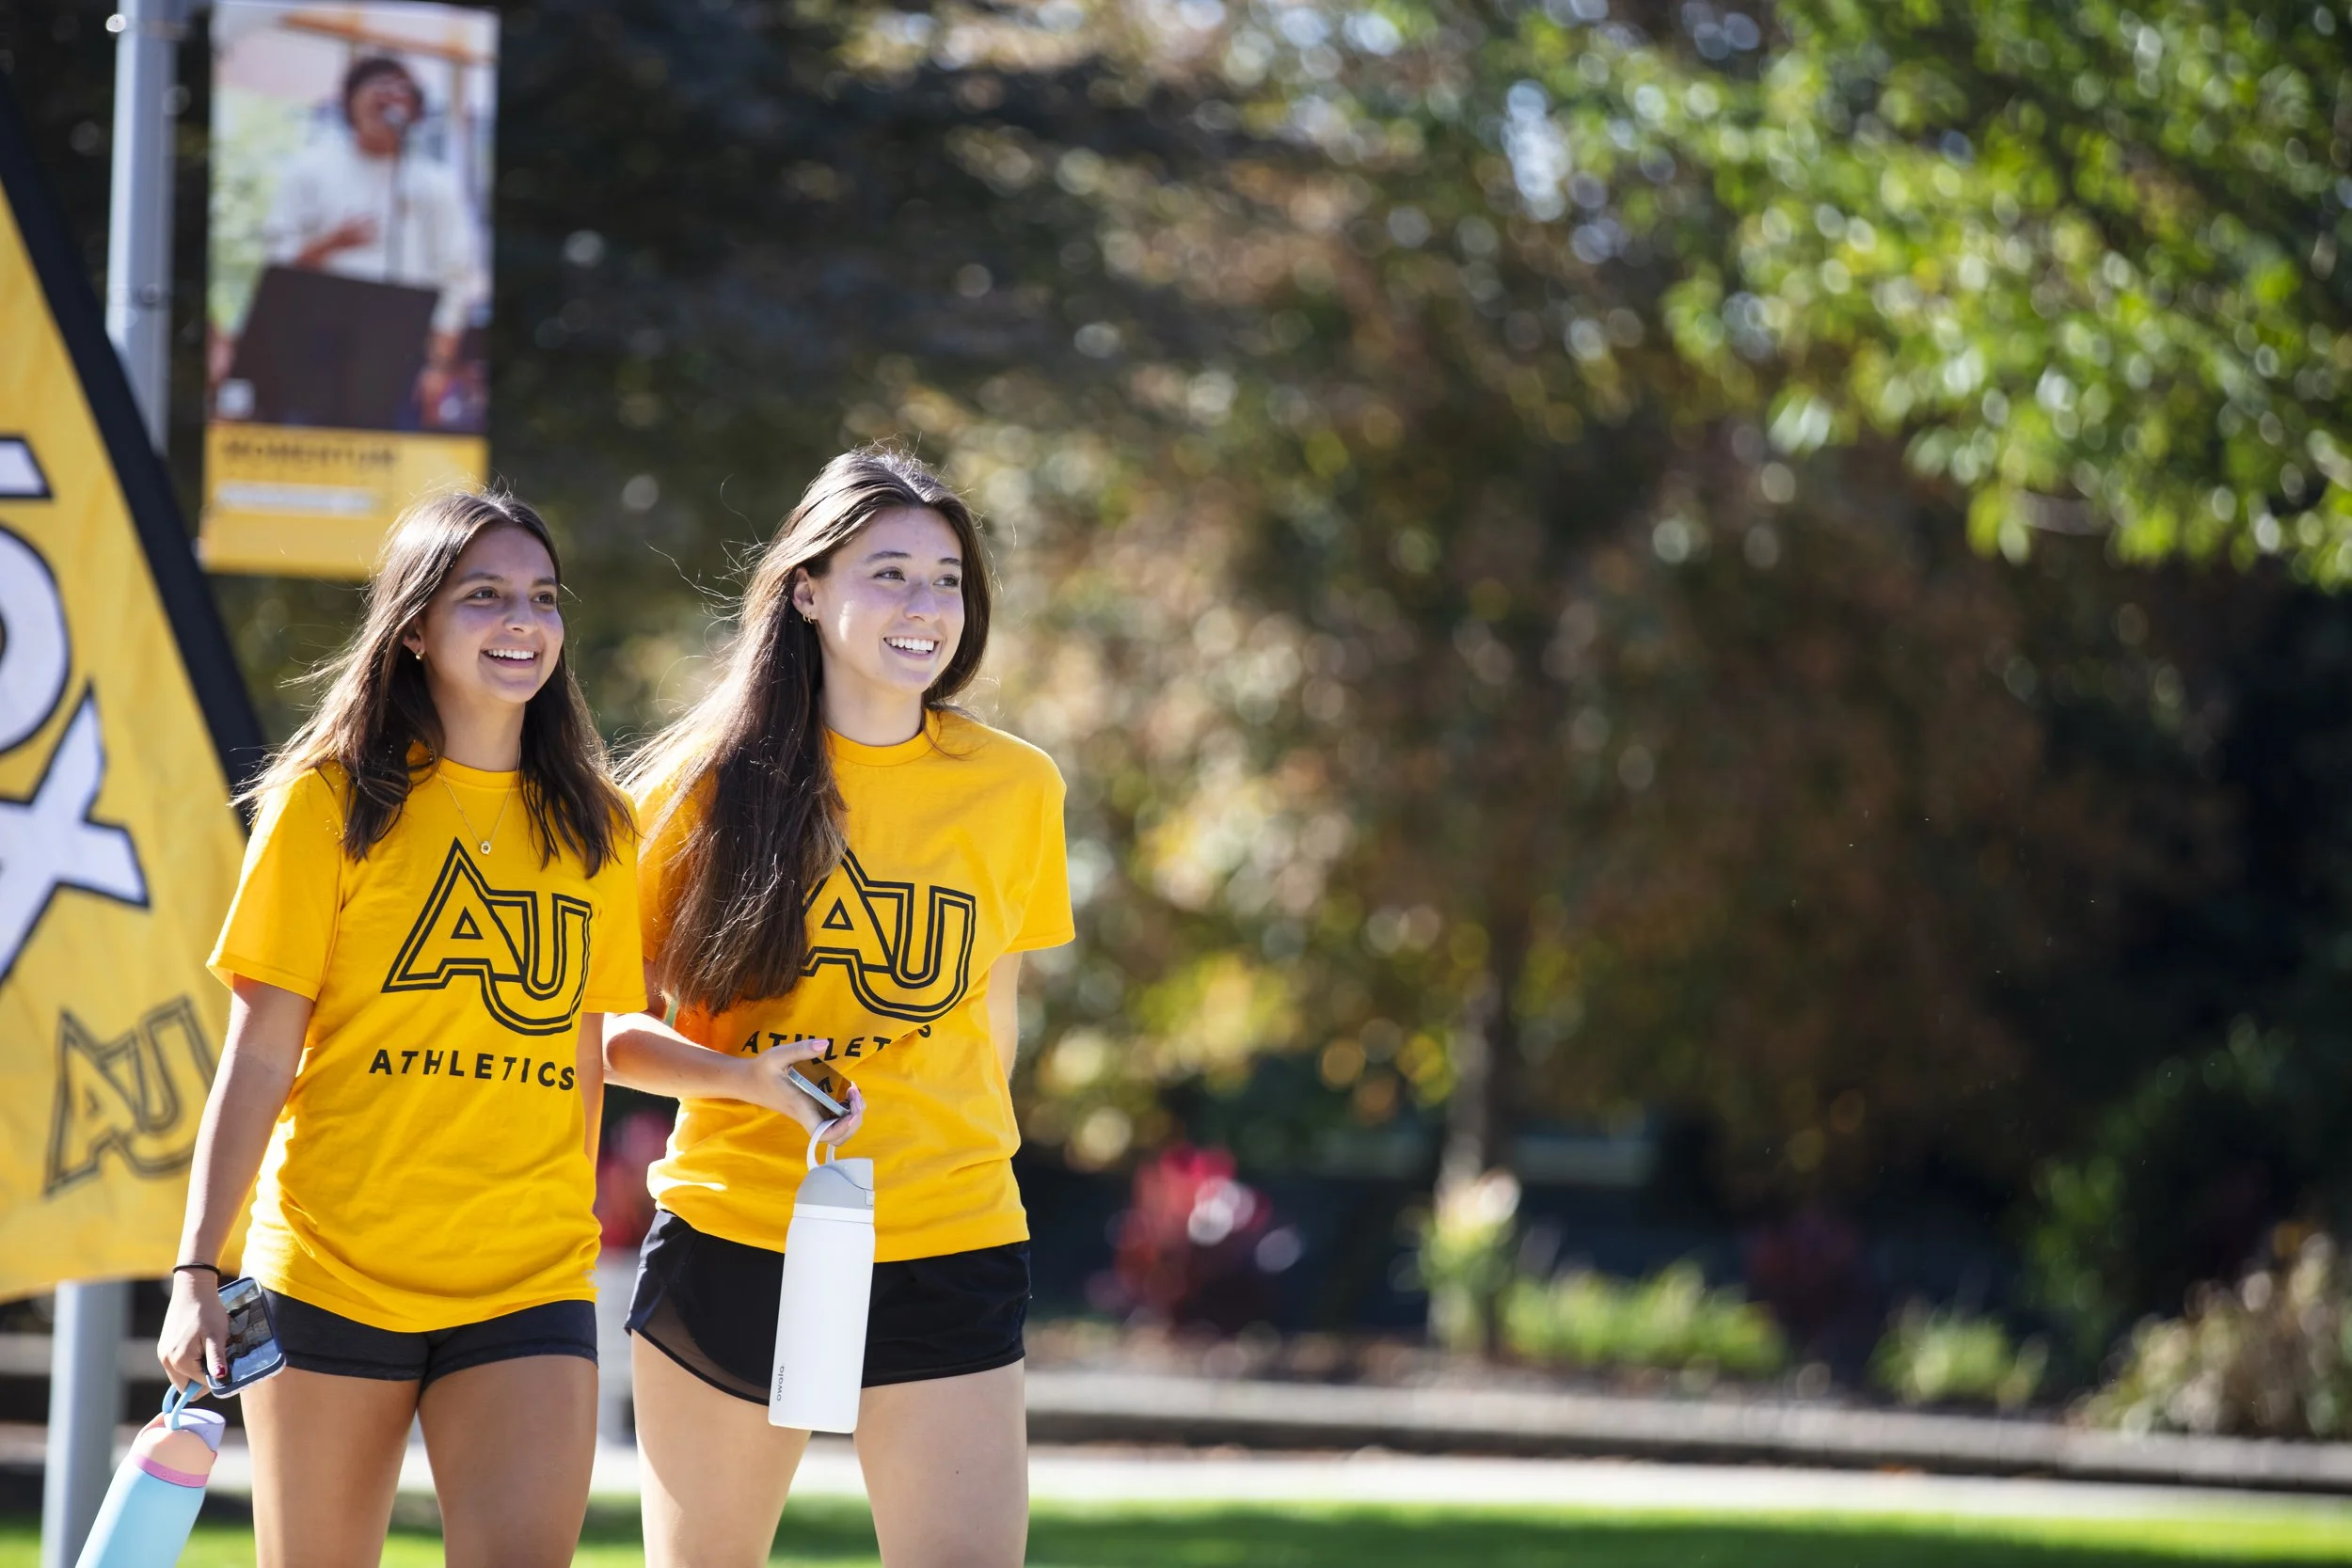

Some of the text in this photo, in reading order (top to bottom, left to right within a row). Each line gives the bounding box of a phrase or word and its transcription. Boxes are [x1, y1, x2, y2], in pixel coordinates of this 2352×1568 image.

[380, 836, 593, 1036] AU
[801, 847, 977, 1022] AU
[369, 1049, 575, 1091] ATHLETICS
[776, 1366, 785, 1402] owala
